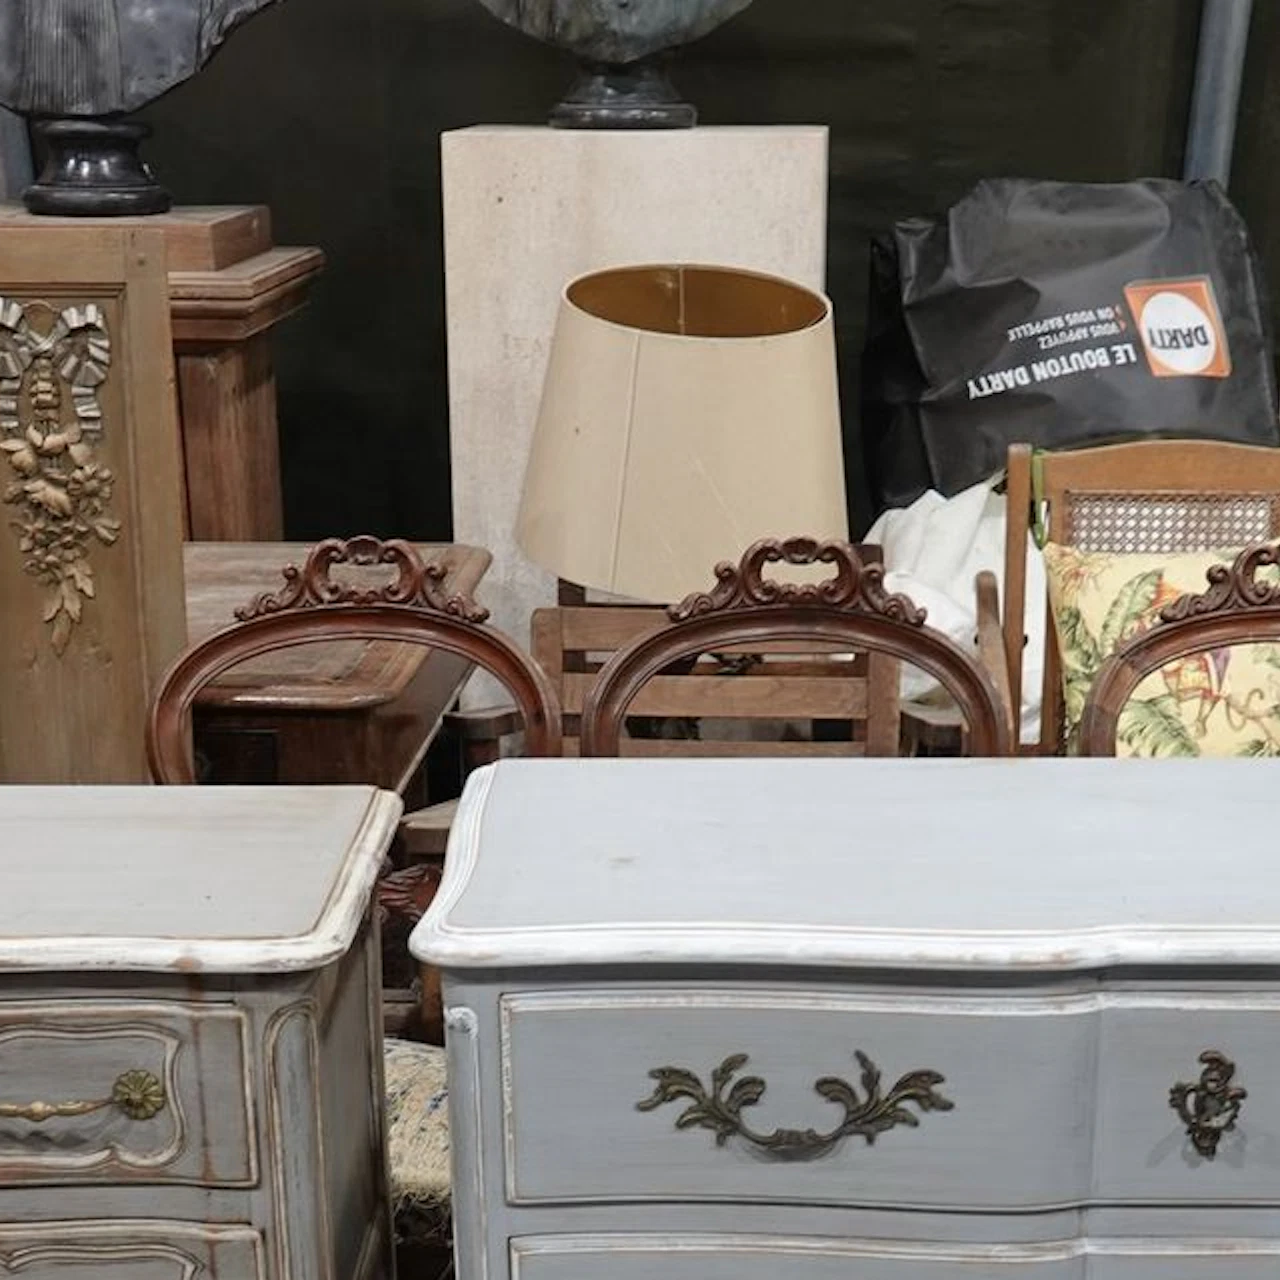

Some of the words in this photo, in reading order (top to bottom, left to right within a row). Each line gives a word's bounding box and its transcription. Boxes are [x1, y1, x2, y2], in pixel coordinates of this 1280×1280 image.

[1065, 309, 1096, 325] VOUS
[1097, 307, 1115, 320] ON
[1008, 314, 1064, 342] RAPPELLE
[1039, 327, 1088, 349] APPUYEZ
[1088, 322, 1120, 338] VOUS
[1149, 325, 1209, 349] DARTY
[1031, 348, 1111, 379] BOUTON
[1114, 343, 1137, 363] LE
[968, 369, 1030, 400] DARTY
